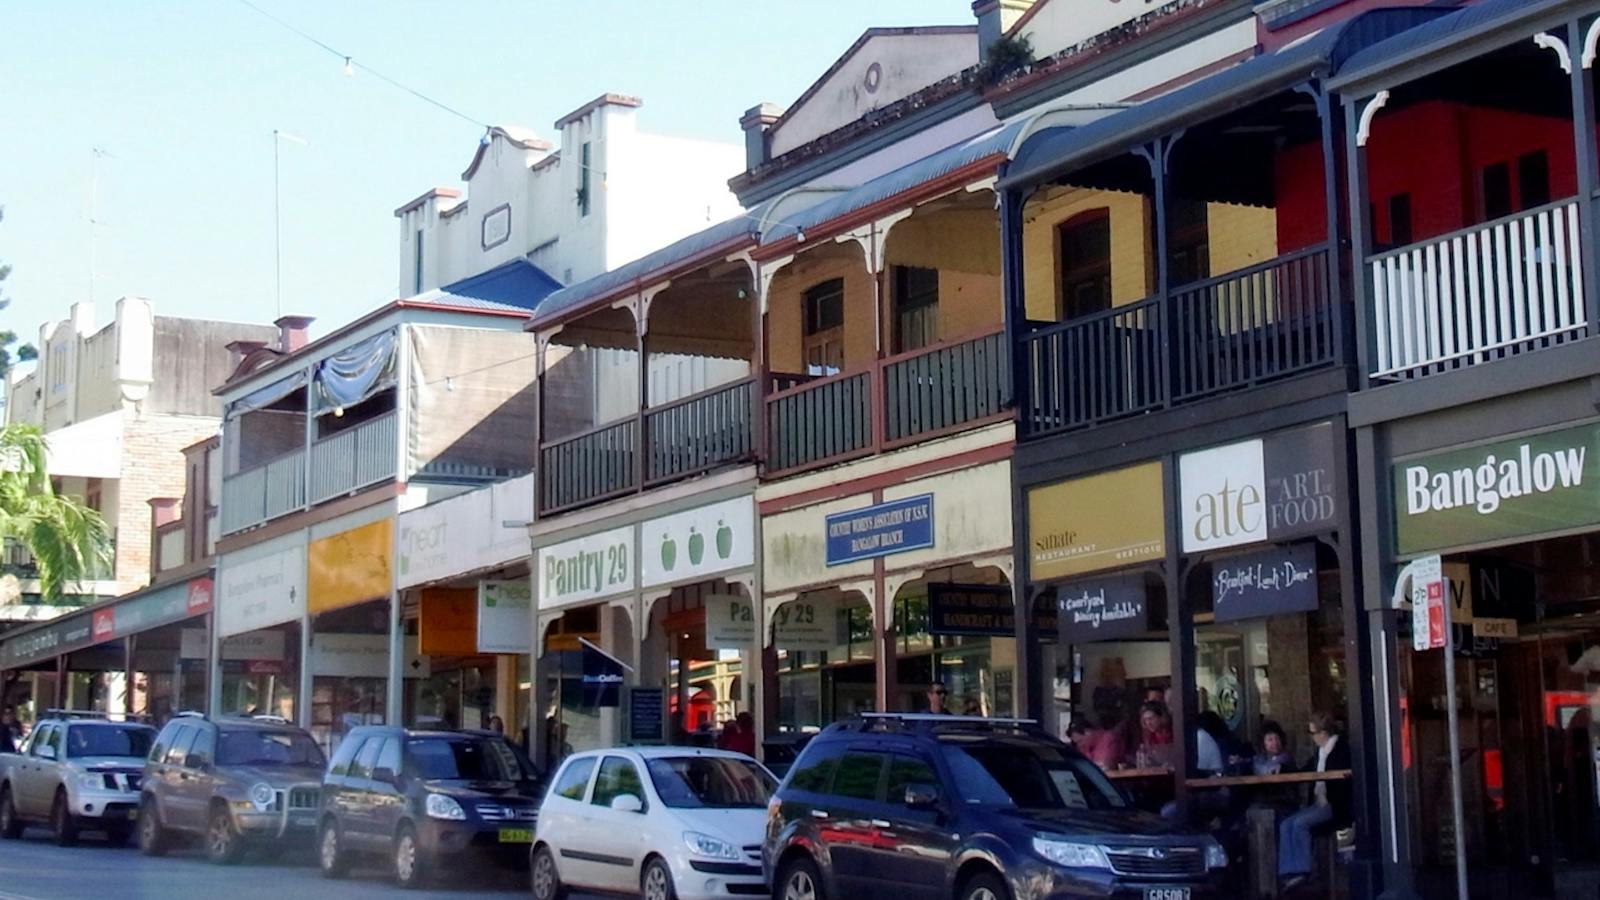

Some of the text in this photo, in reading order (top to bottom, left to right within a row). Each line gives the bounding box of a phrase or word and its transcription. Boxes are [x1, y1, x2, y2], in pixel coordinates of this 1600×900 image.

[1279, 468, 1325, 502] ART
[1406, 444, 1586, 515] Bangalow
[1194, 476, 1263, 541] ate
[1271, 495, 1335, 529] FOOD
[1035, 543, 1097, 560] RESTAURANT
[545, 549, 605, 600] Pantry
[608, 543, 628, 586] 29
[795, 603, 815, 624] 29
